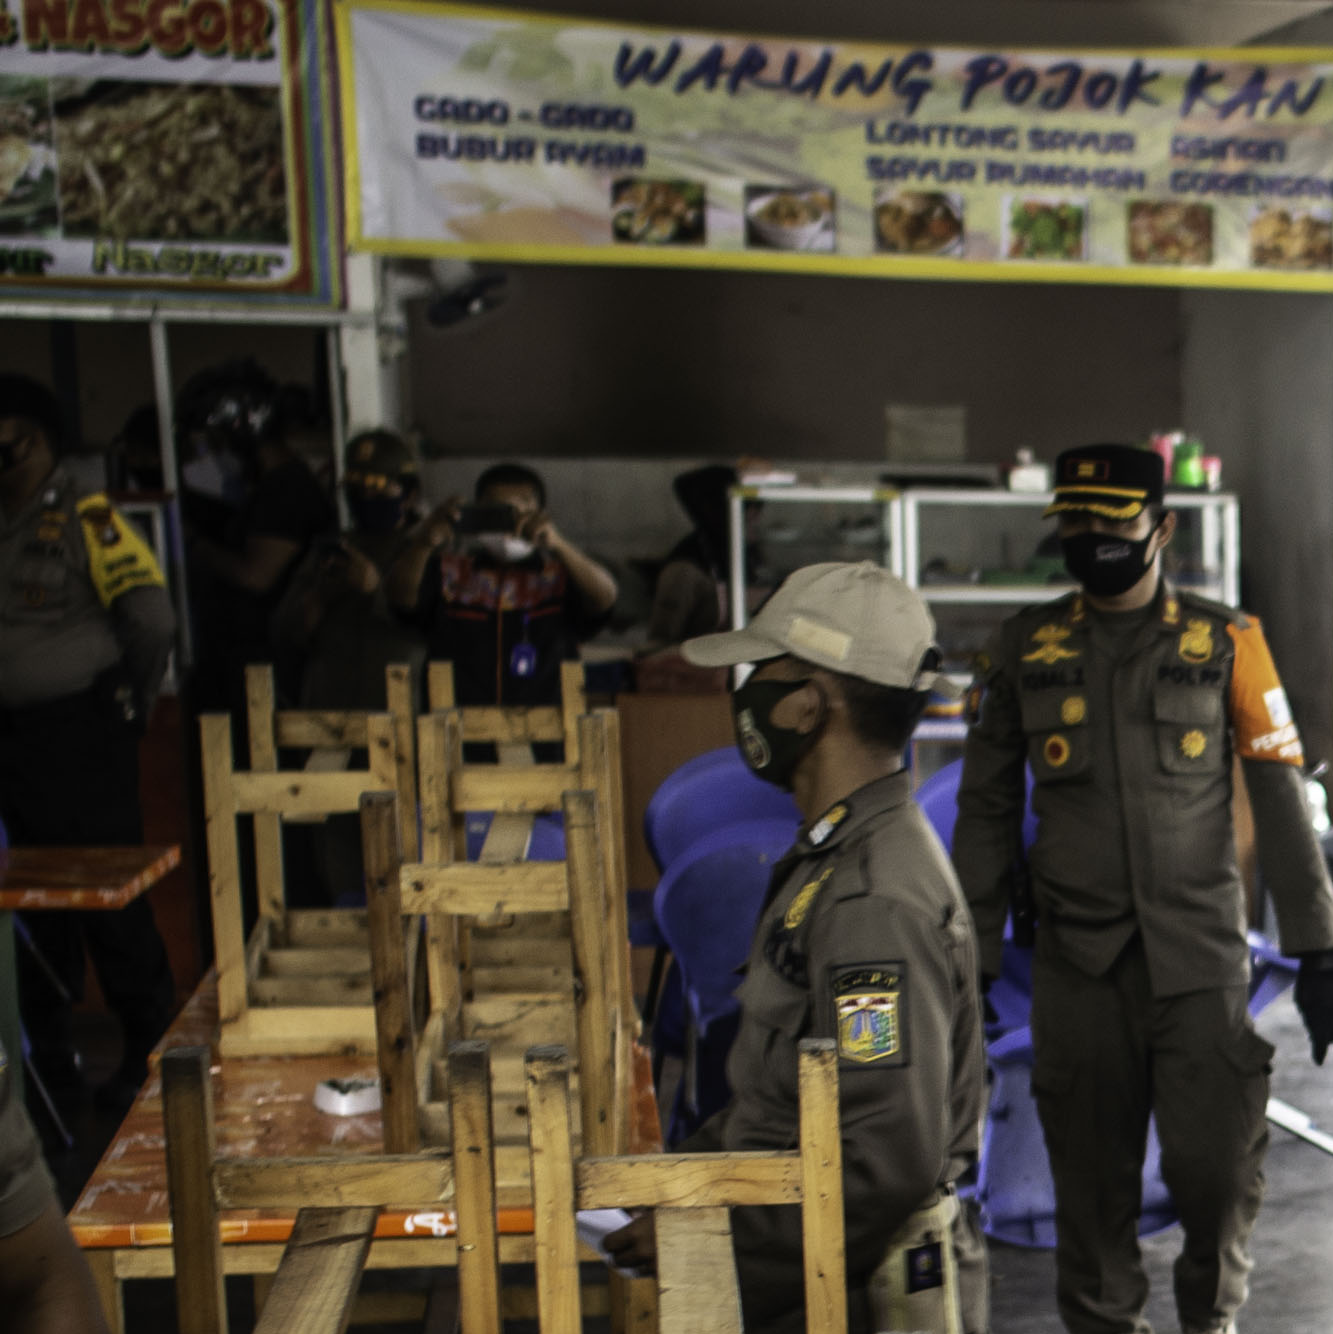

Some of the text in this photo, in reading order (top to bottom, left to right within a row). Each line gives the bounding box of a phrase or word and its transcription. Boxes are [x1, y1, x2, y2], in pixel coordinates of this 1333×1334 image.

[23, 0, 275, 60] NASGOR
[614, 40, 1325, 119] WARUNG POJOK KAN
[416, 134, 536, 162] BUBUR
[866, 121, 1136, 153] LONTONG SAYUR
